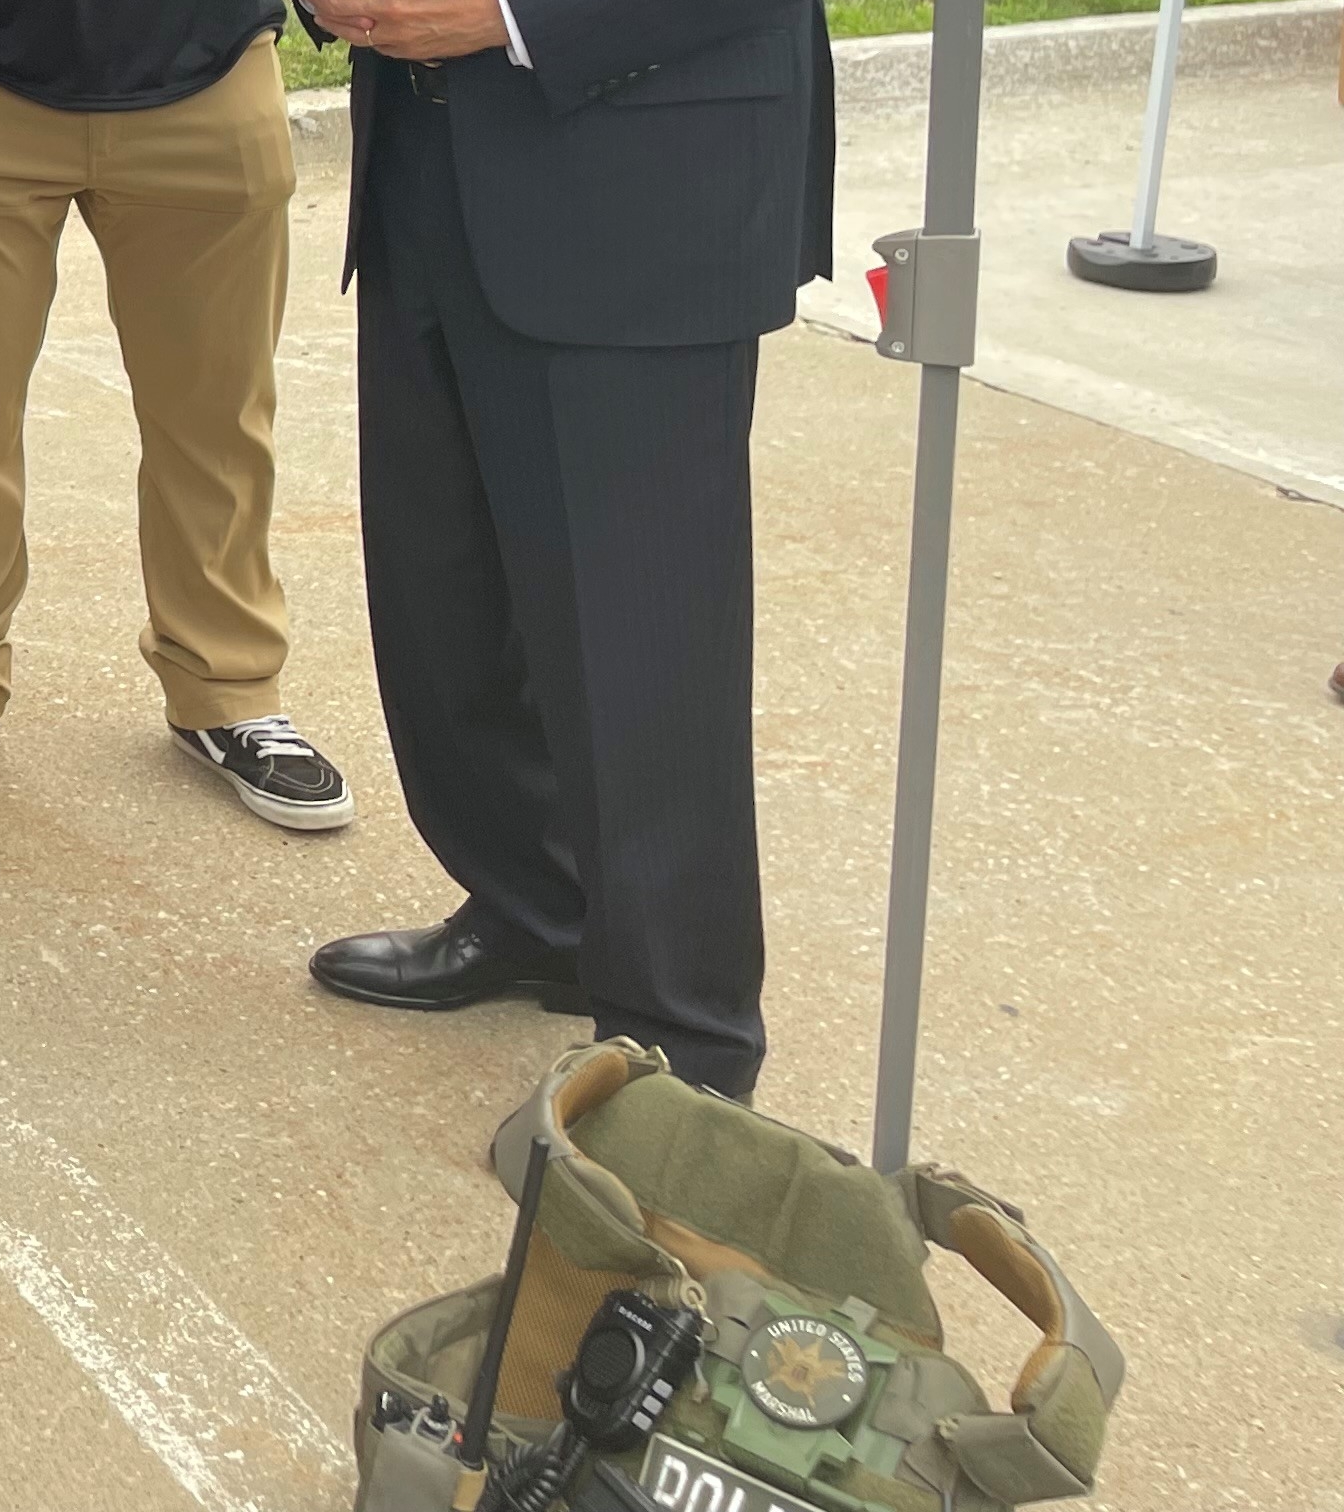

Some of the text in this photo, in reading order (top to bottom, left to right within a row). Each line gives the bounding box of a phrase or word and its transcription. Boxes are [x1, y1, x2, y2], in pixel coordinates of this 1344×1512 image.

[767, 1319, 865, 1383] UNITED STATES
[751, 1380, 817, 1423] MARSHAL
